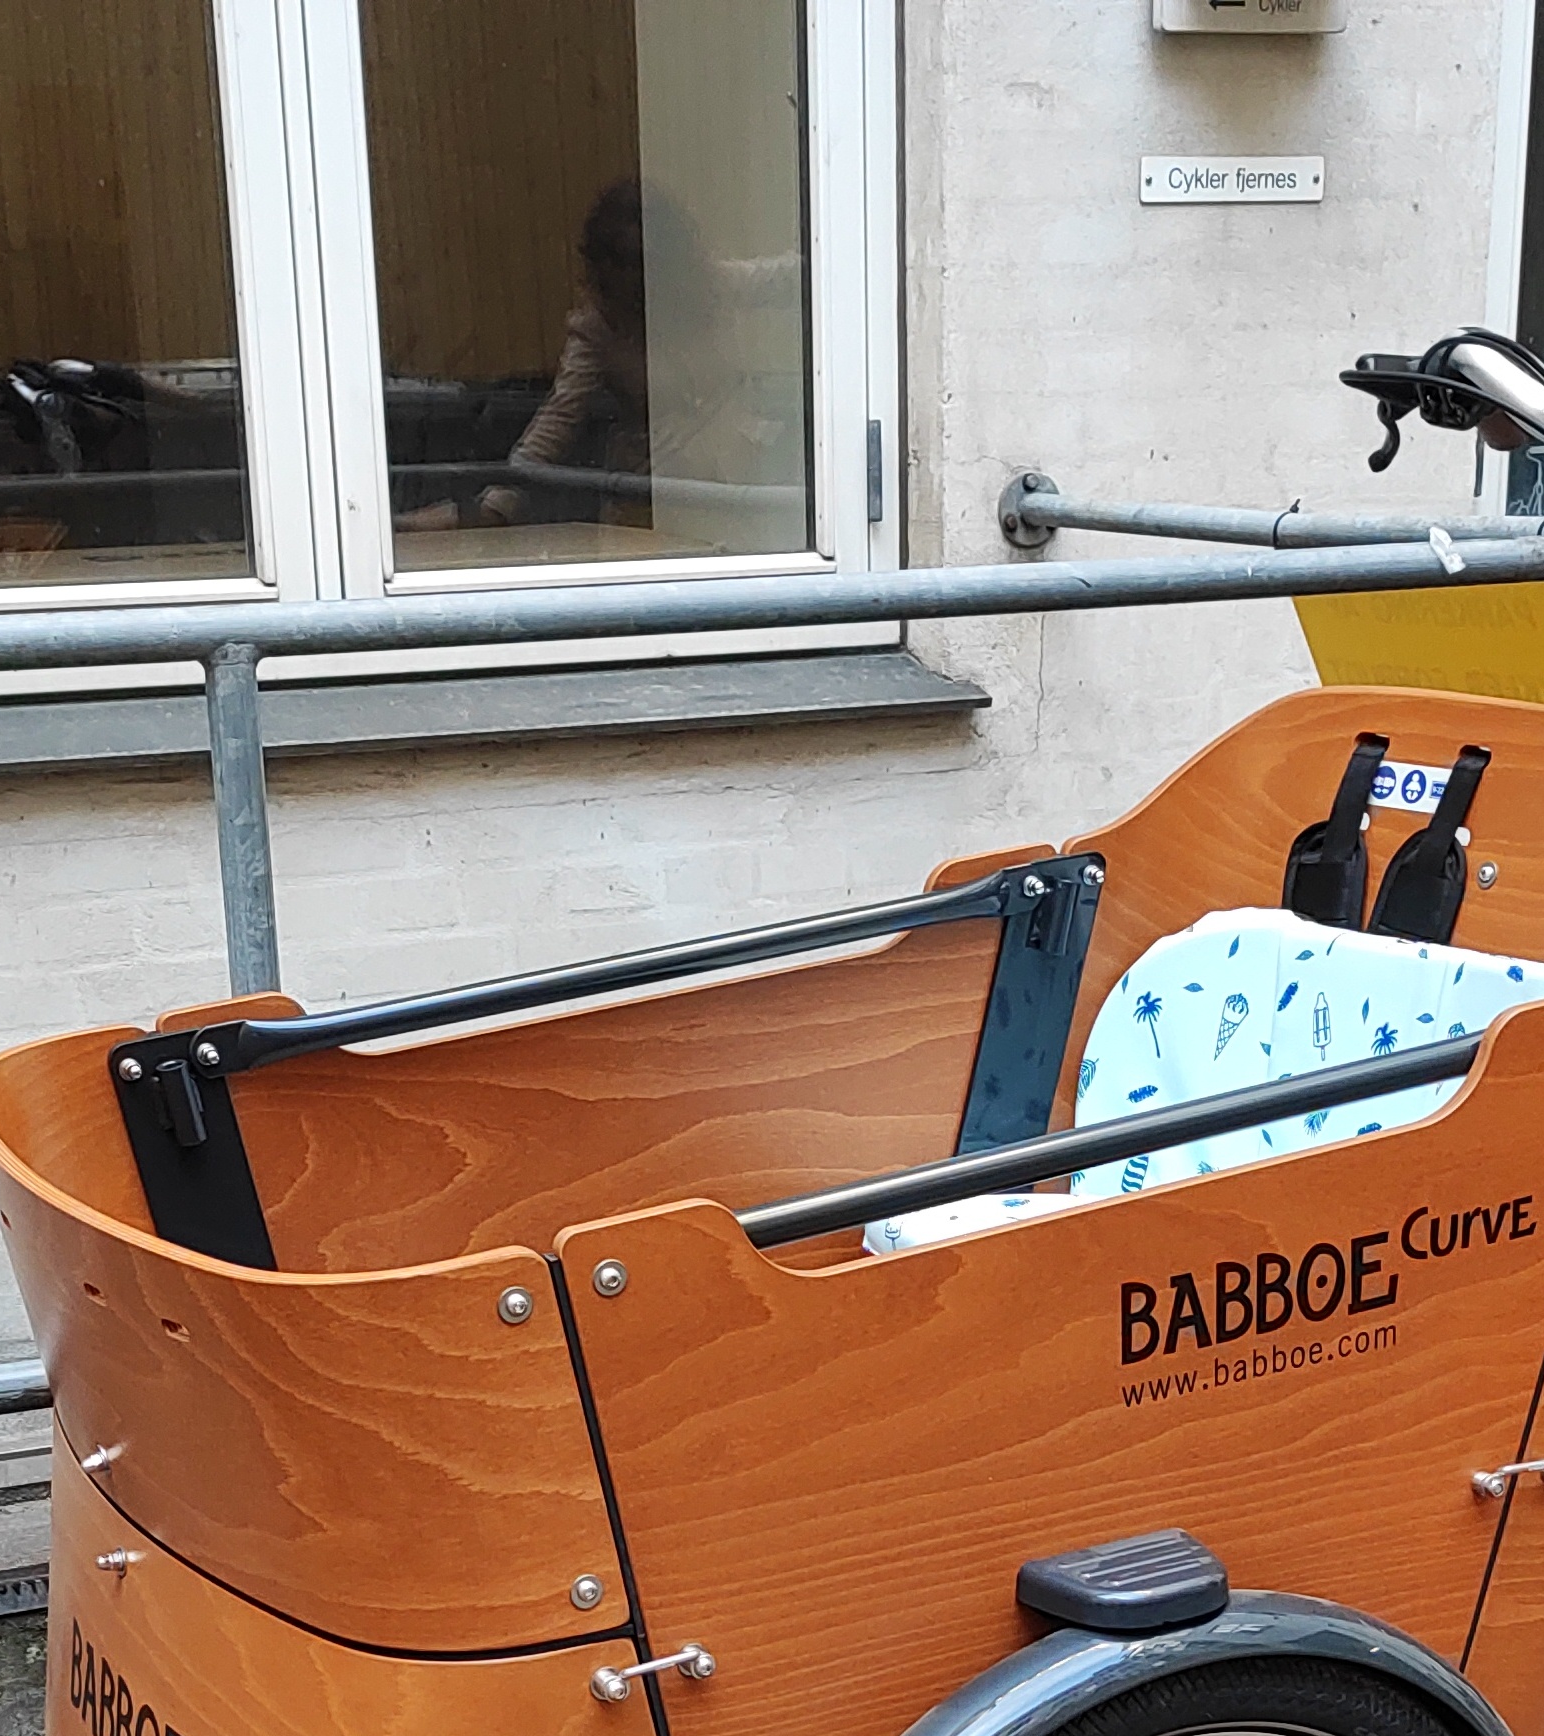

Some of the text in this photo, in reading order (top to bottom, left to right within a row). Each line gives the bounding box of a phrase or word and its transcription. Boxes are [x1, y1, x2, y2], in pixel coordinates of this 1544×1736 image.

[1258, 0, 1302, 15] Cykler
[1168, 167, 1297, 194] Cykler fjernes
[1121, 1231, 1399, 1365] BABBOE
[1121, 1323, 1398, 1408] www.babboe.com
